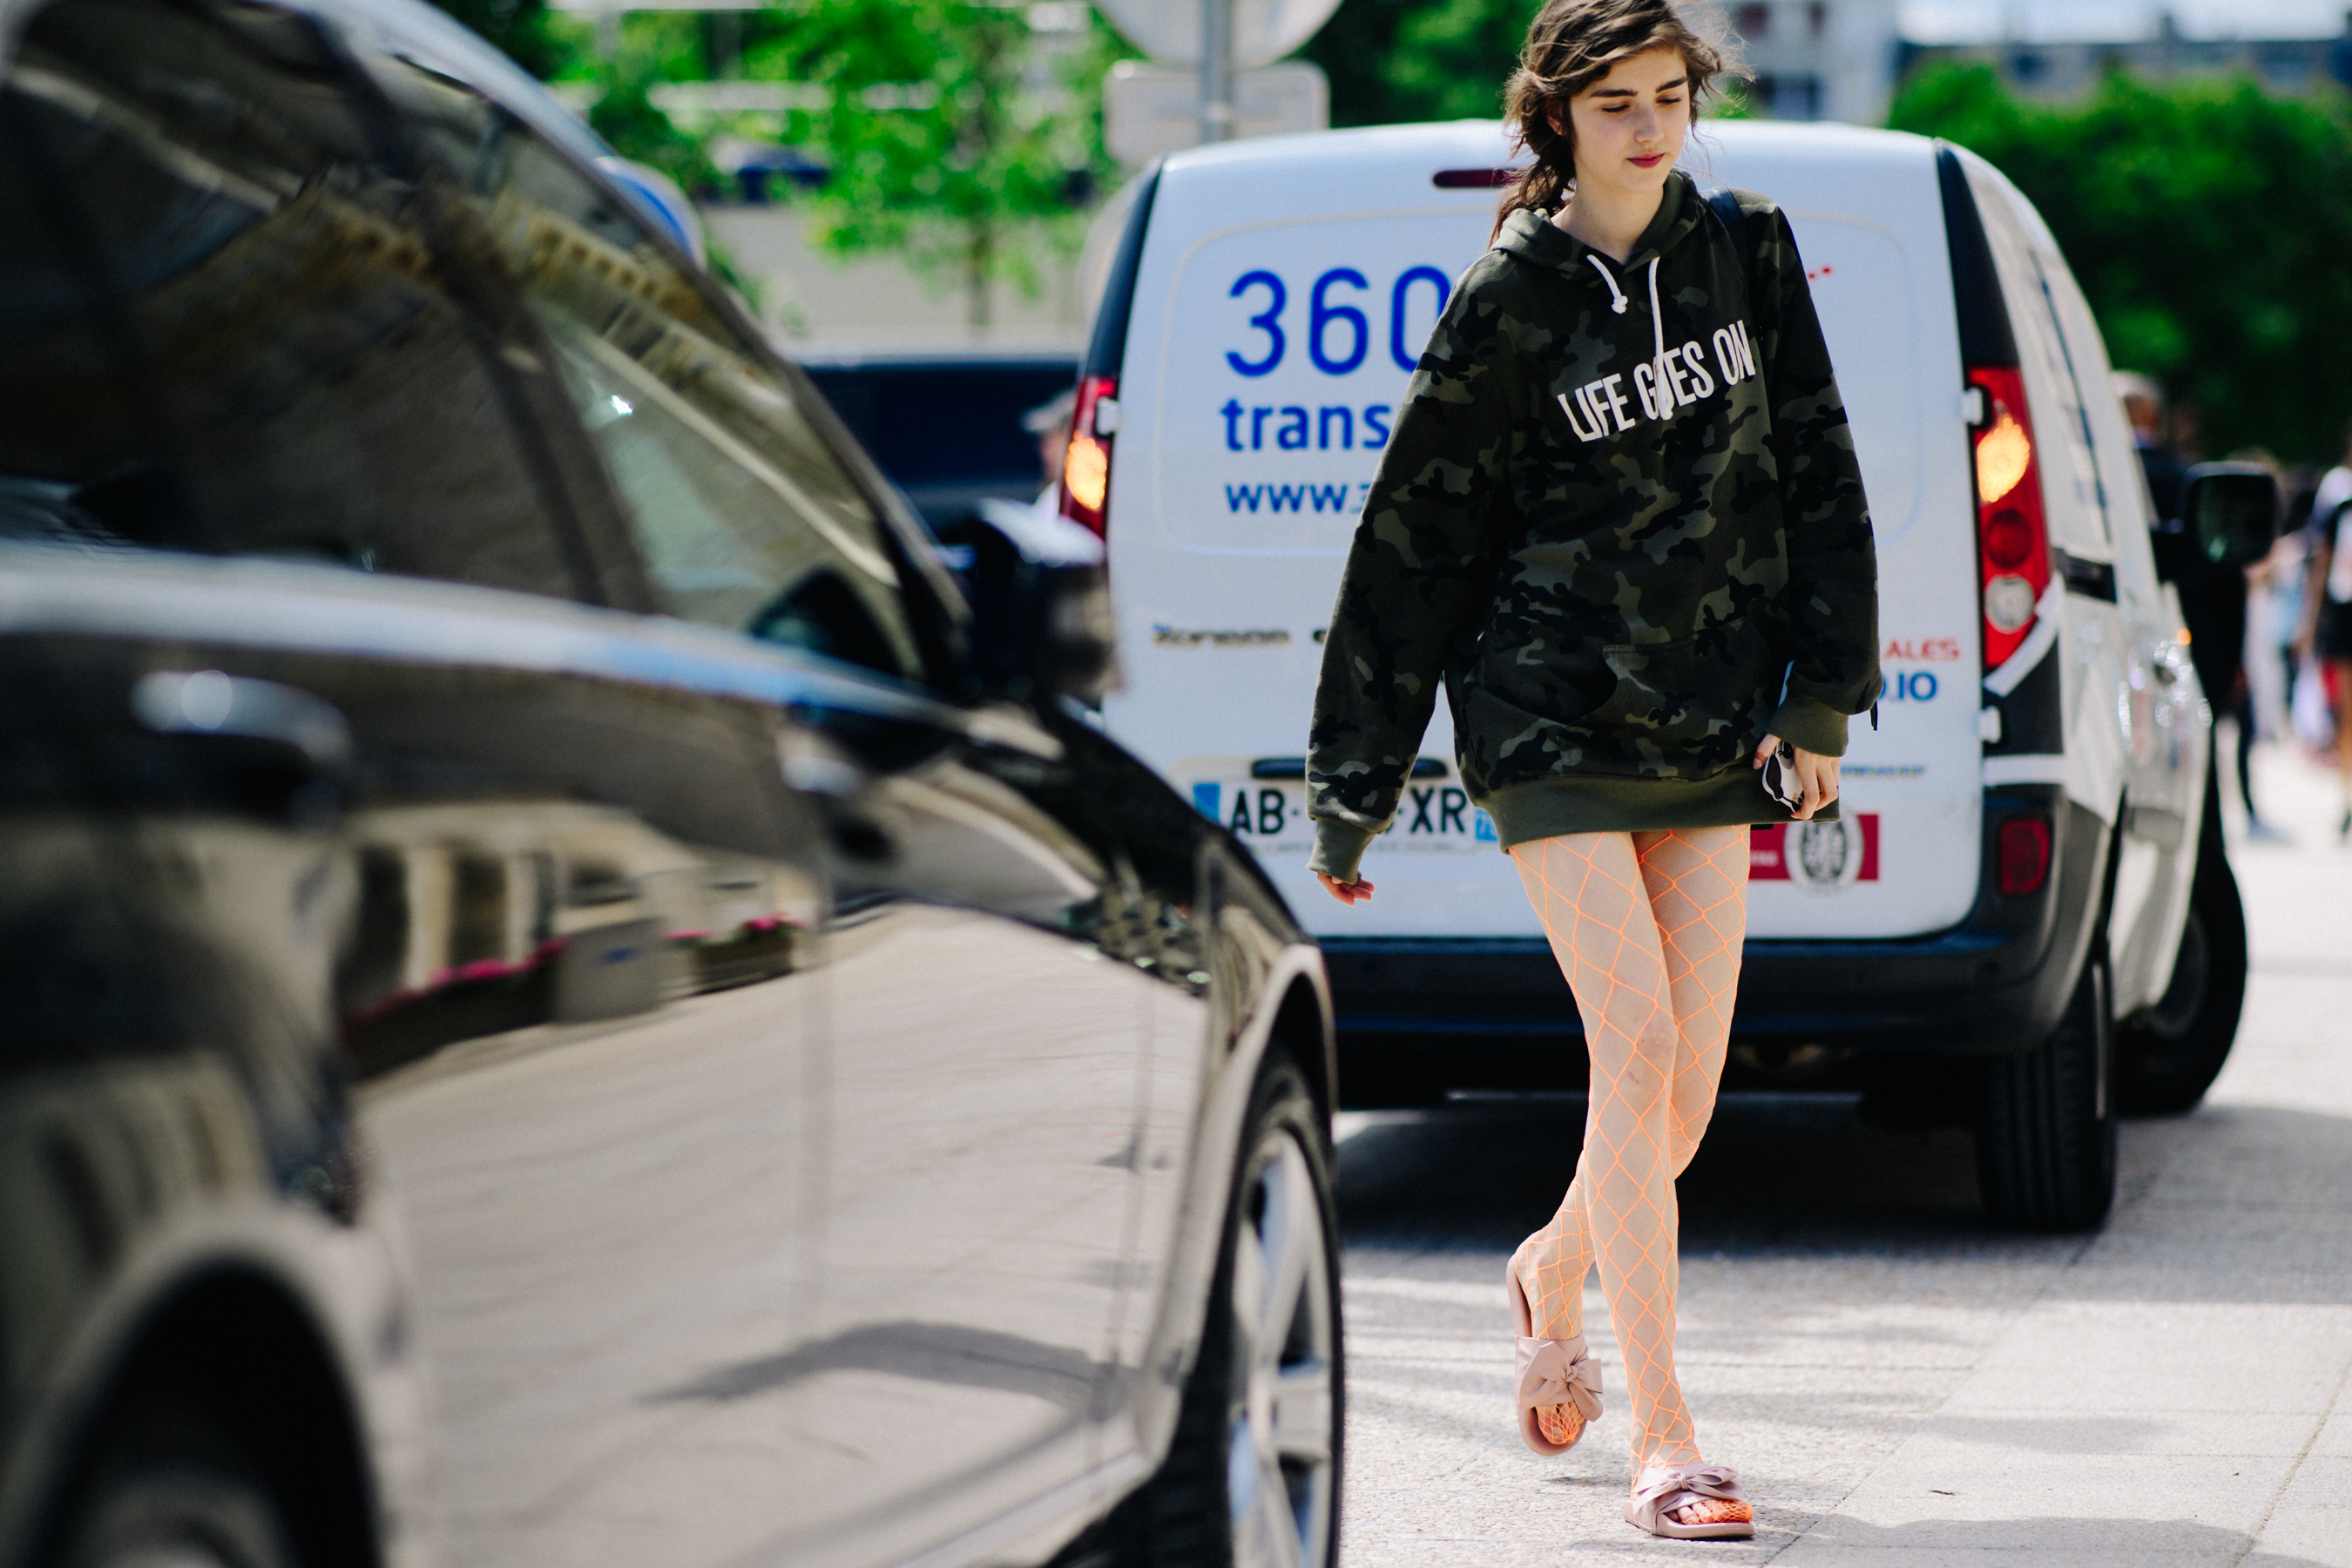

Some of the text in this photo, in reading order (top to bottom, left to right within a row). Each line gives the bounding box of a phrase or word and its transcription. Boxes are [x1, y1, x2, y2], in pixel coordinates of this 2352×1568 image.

[1226, 265, 1451, 376] 360
[1558, 320, 1756, 442] LIFE GOES ON
